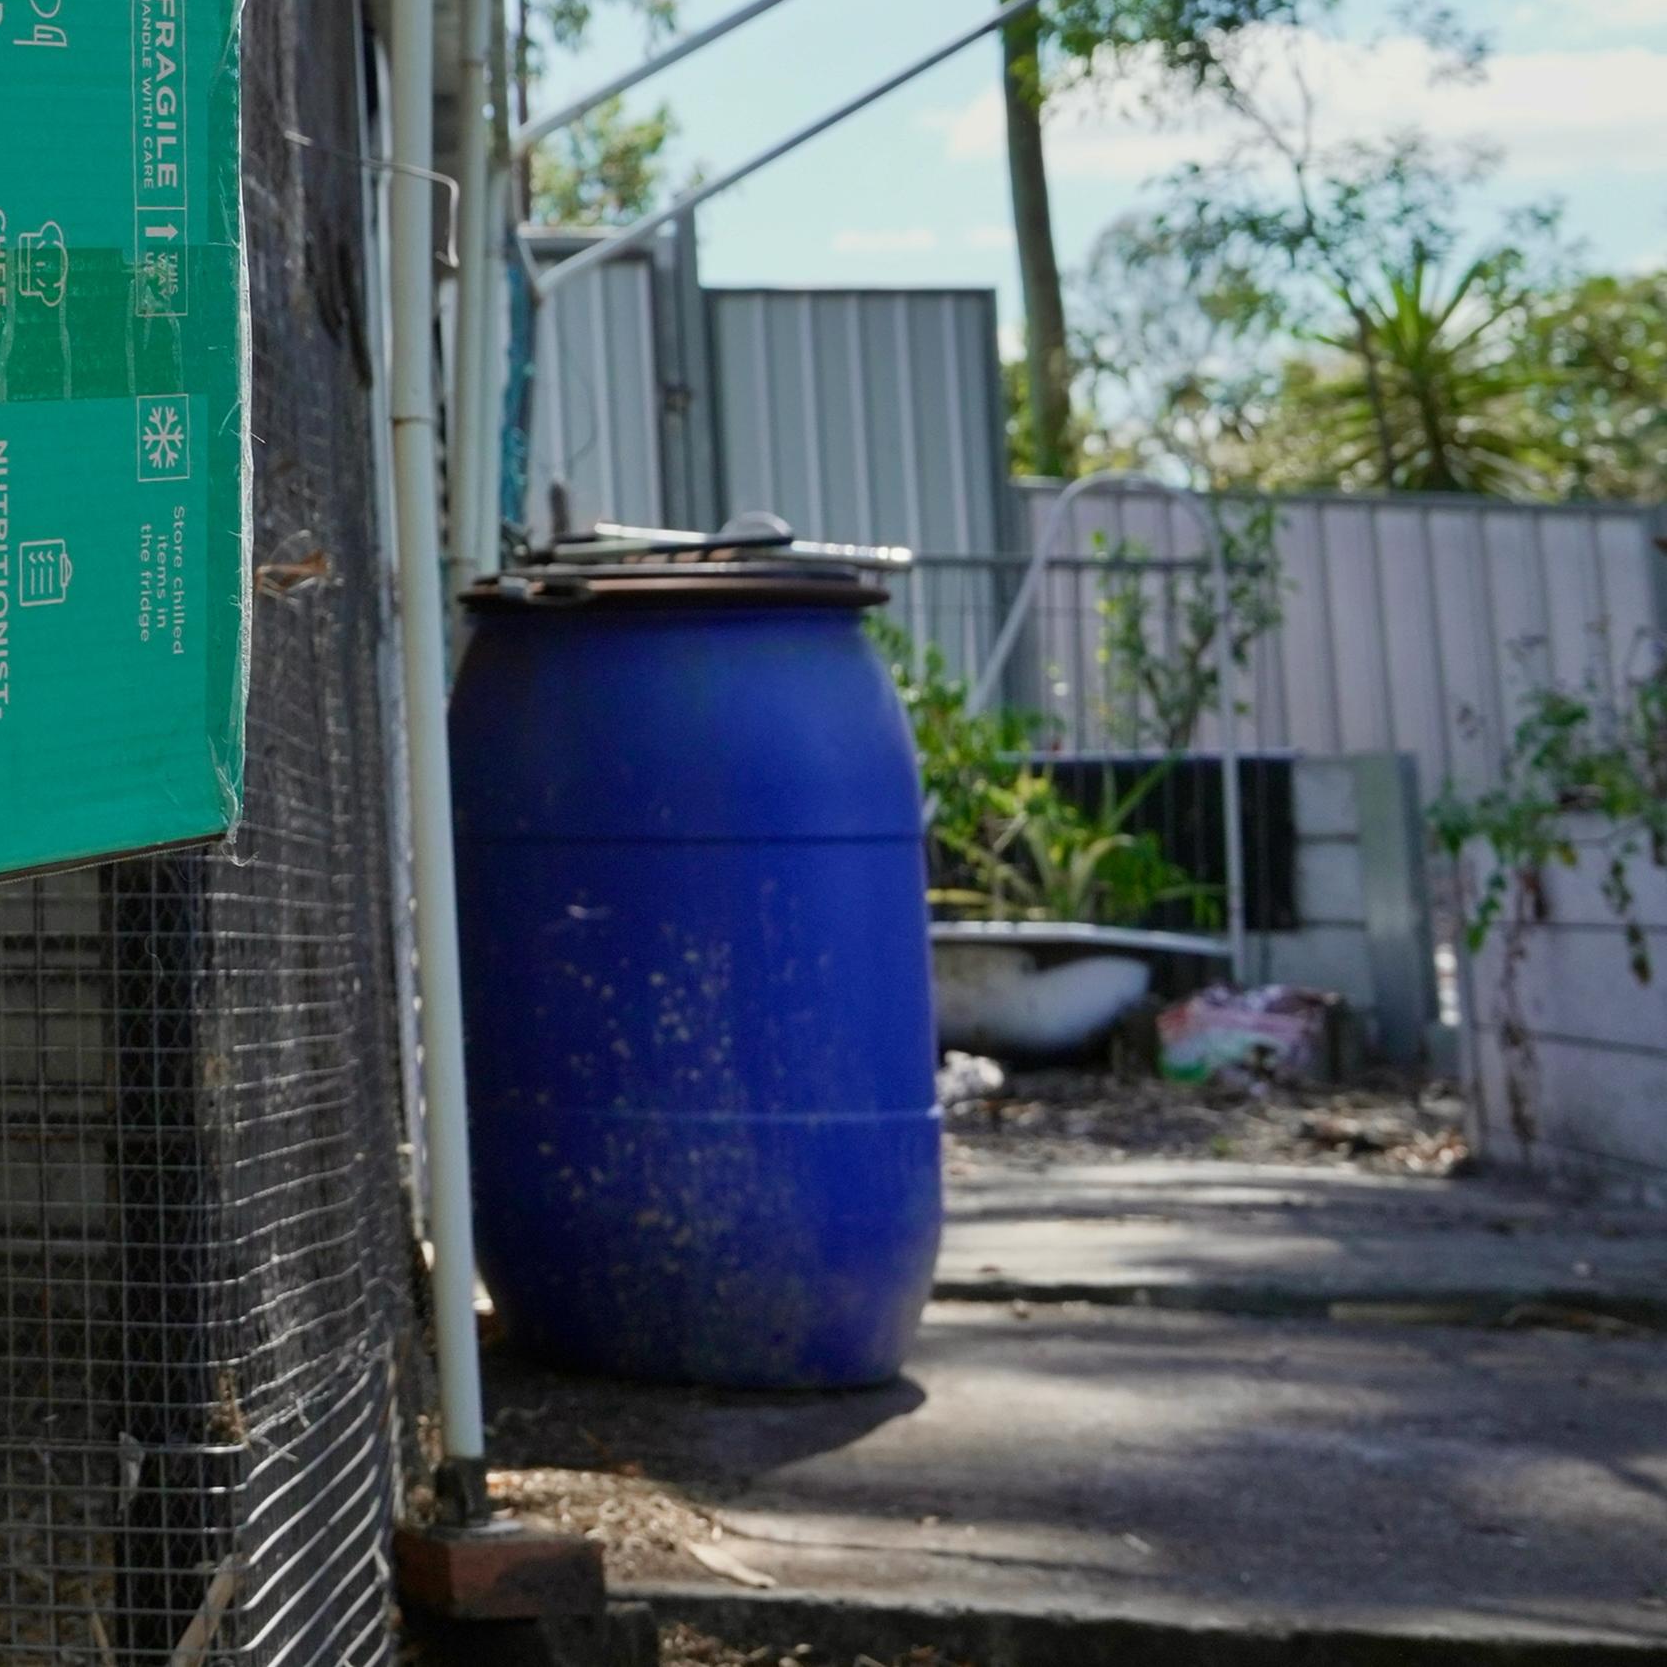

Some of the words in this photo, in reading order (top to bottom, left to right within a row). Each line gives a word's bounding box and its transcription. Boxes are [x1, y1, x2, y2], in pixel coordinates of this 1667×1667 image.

[143, 78, 153, 127] WITH
[144, 136, 153, 187] CARE
[158, 252, 167, 298] WAY
[169, 252, 178, 295] THIS
[141, 524, 153, 561] the
[173, 506, 185, 568] Store
[157, 535, 169, 596] items
[139, 571, 152, 641] fridge
[157, 608, 168, 629] in
[173, 577, 185, 655] chilled
